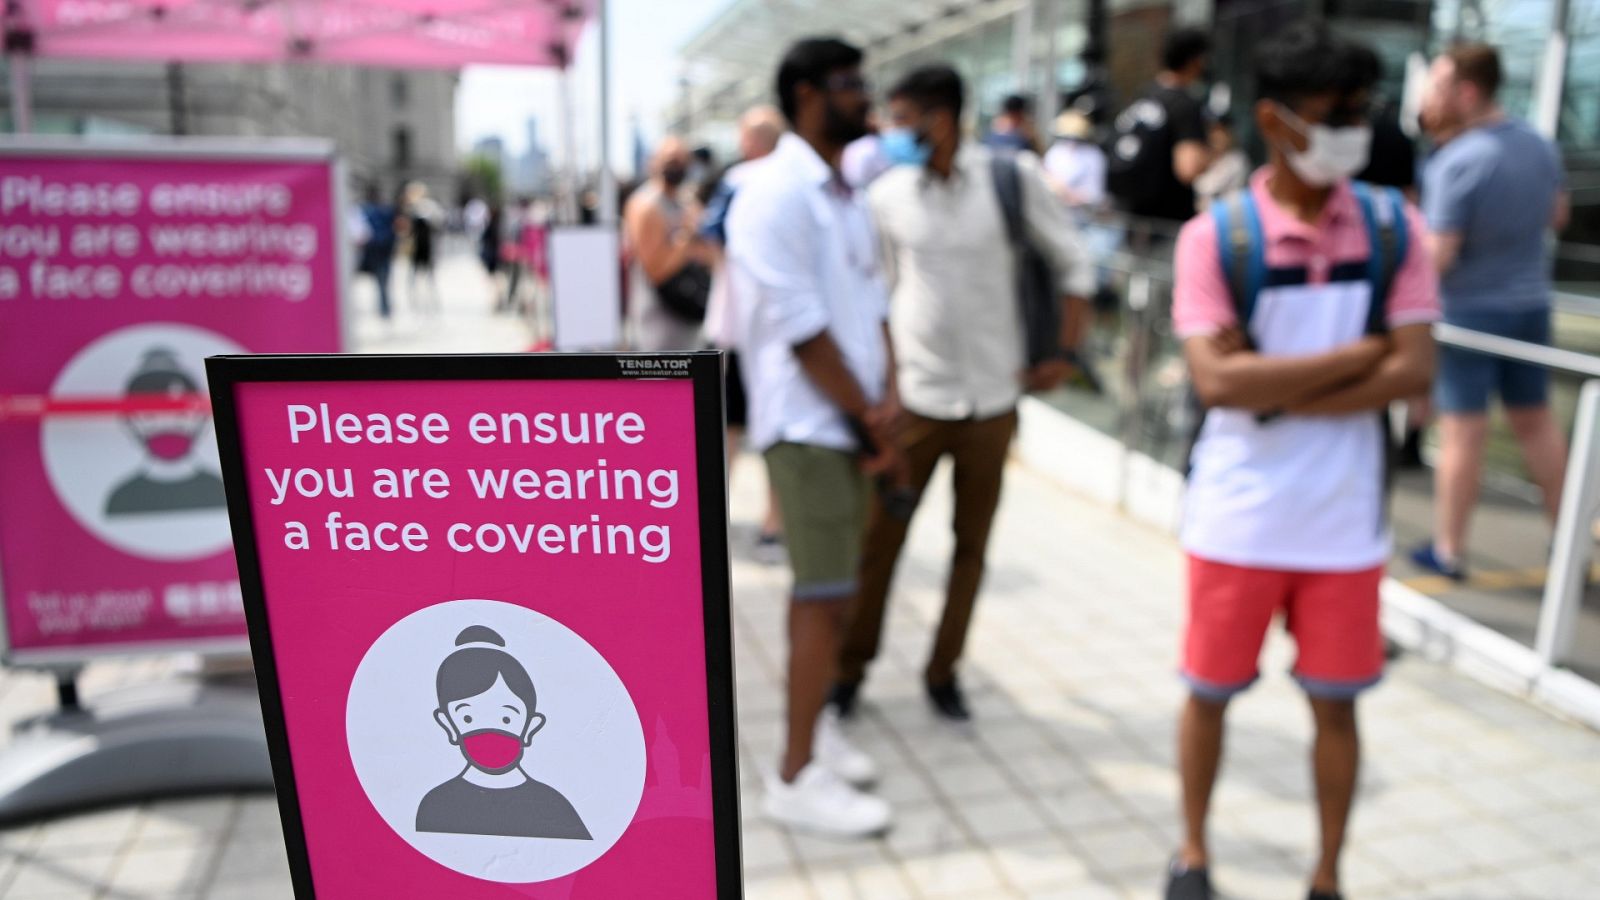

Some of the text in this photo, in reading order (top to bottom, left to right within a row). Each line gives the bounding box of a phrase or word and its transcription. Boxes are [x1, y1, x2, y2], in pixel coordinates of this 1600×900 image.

[2, 176, 291, 215] Please ensure
[0, 223, 318, 261] ou are wearing
[31, 259, 121, 297] face
[131, 262, 311, 302] covering
[287, 403, 646, 444] Please ensure
[264, 459, 679, 508] you are wearing
[284, 511, 671, 563] a face covering
